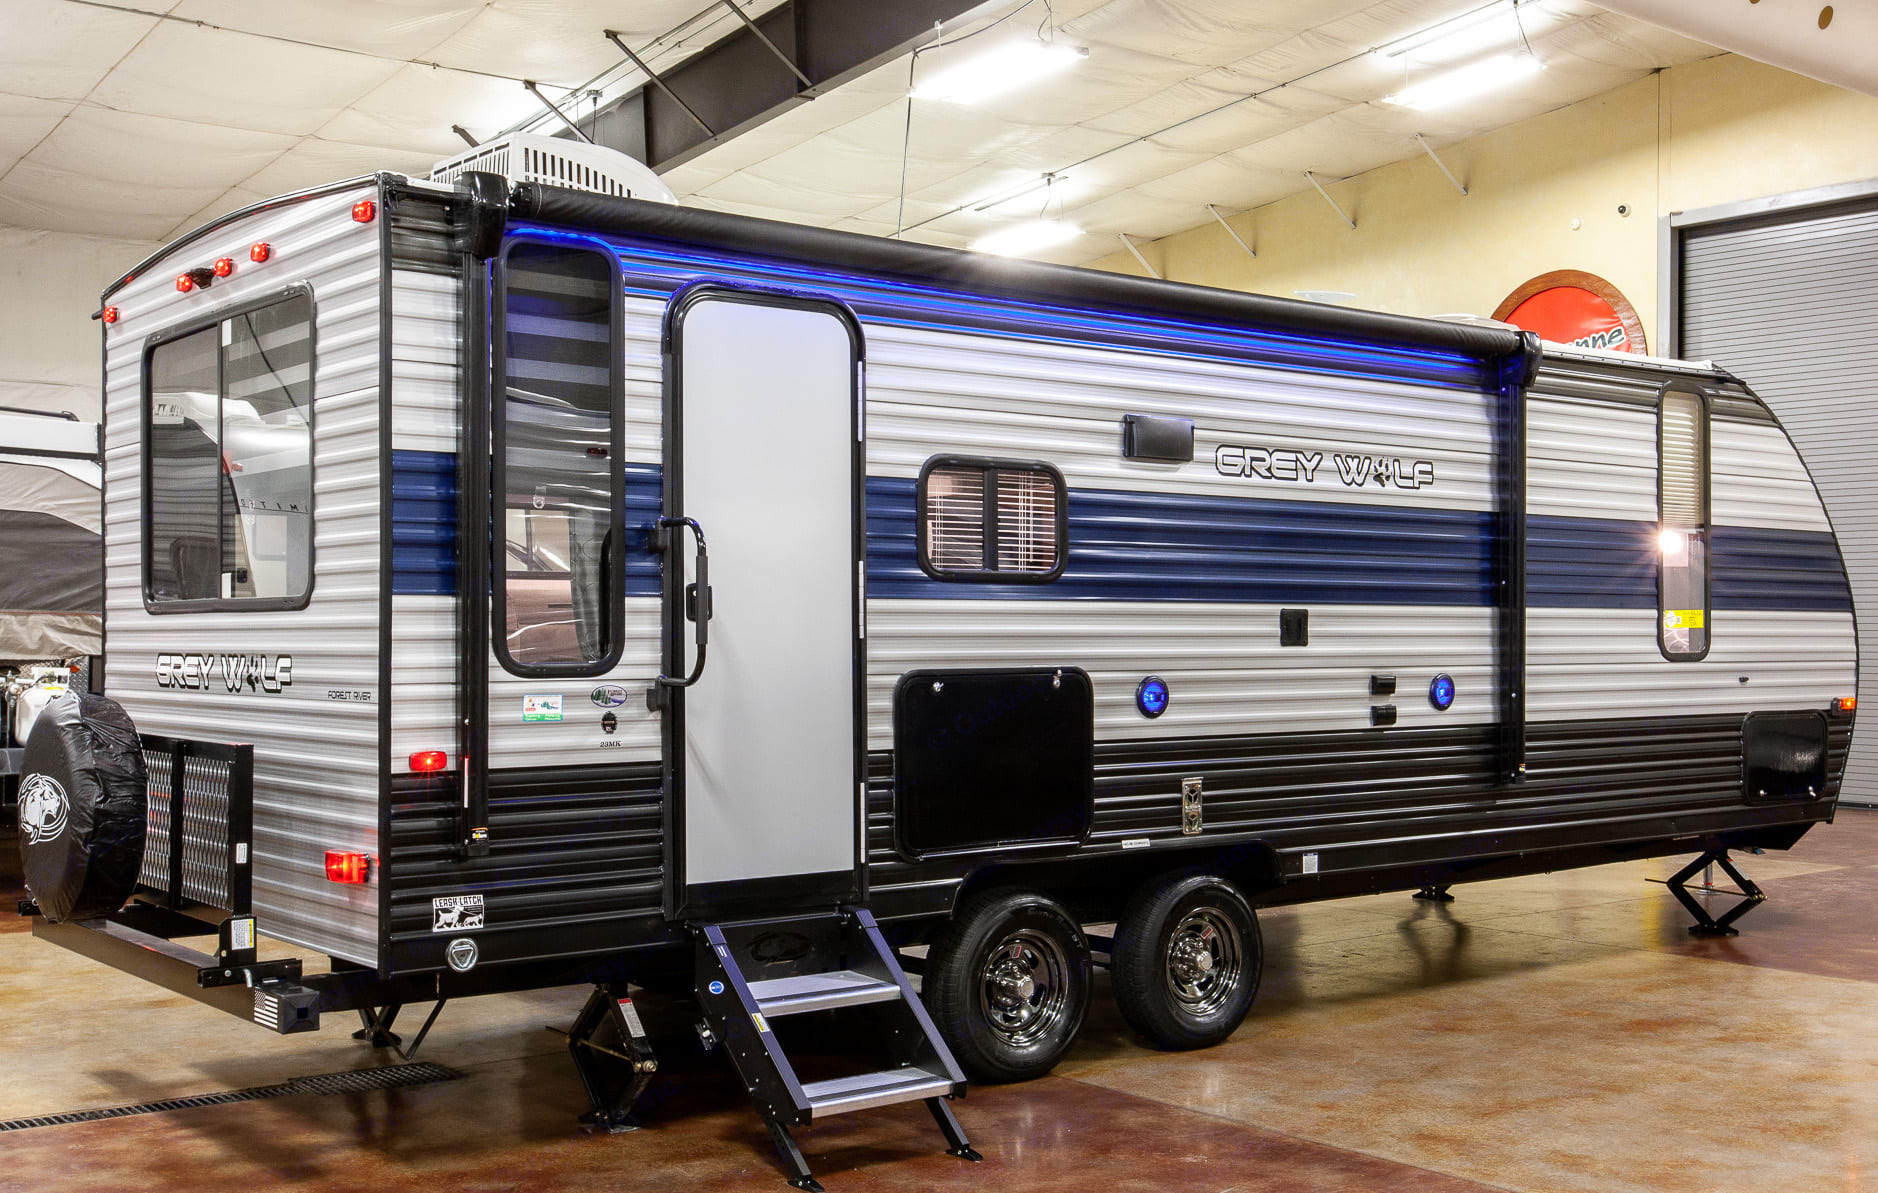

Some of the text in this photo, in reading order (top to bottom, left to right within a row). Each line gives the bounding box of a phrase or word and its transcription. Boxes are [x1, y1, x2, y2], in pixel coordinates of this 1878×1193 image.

[1569, 326, 1625, 350] nne
[1216, 444, 1434, 489] GREY WLF
[156, 652, 292, 694] GREY WLF
[328, 690, 372, 701] FOREST RIVER
[434, 896, 482, 908] LEASH LATCH
